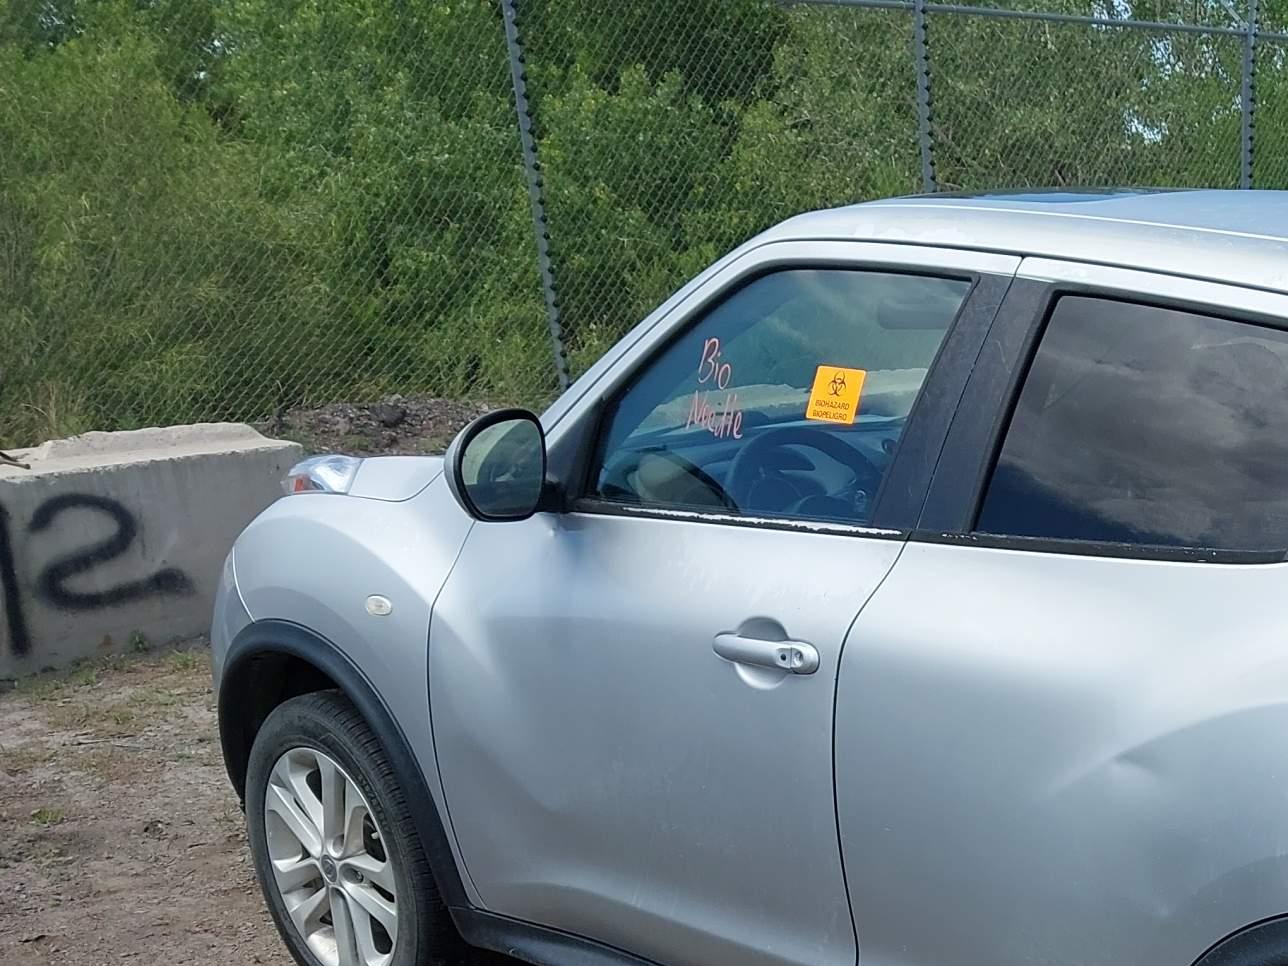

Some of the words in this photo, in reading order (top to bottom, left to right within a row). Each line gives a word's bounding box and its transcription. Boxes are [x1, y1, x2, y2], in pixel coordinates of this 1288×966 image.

[698, 338, 731, 390] Bio
[815, 400, 850, 411] BIOHAZARD
[812, 409, 847, 421] BIOPELIGRO
